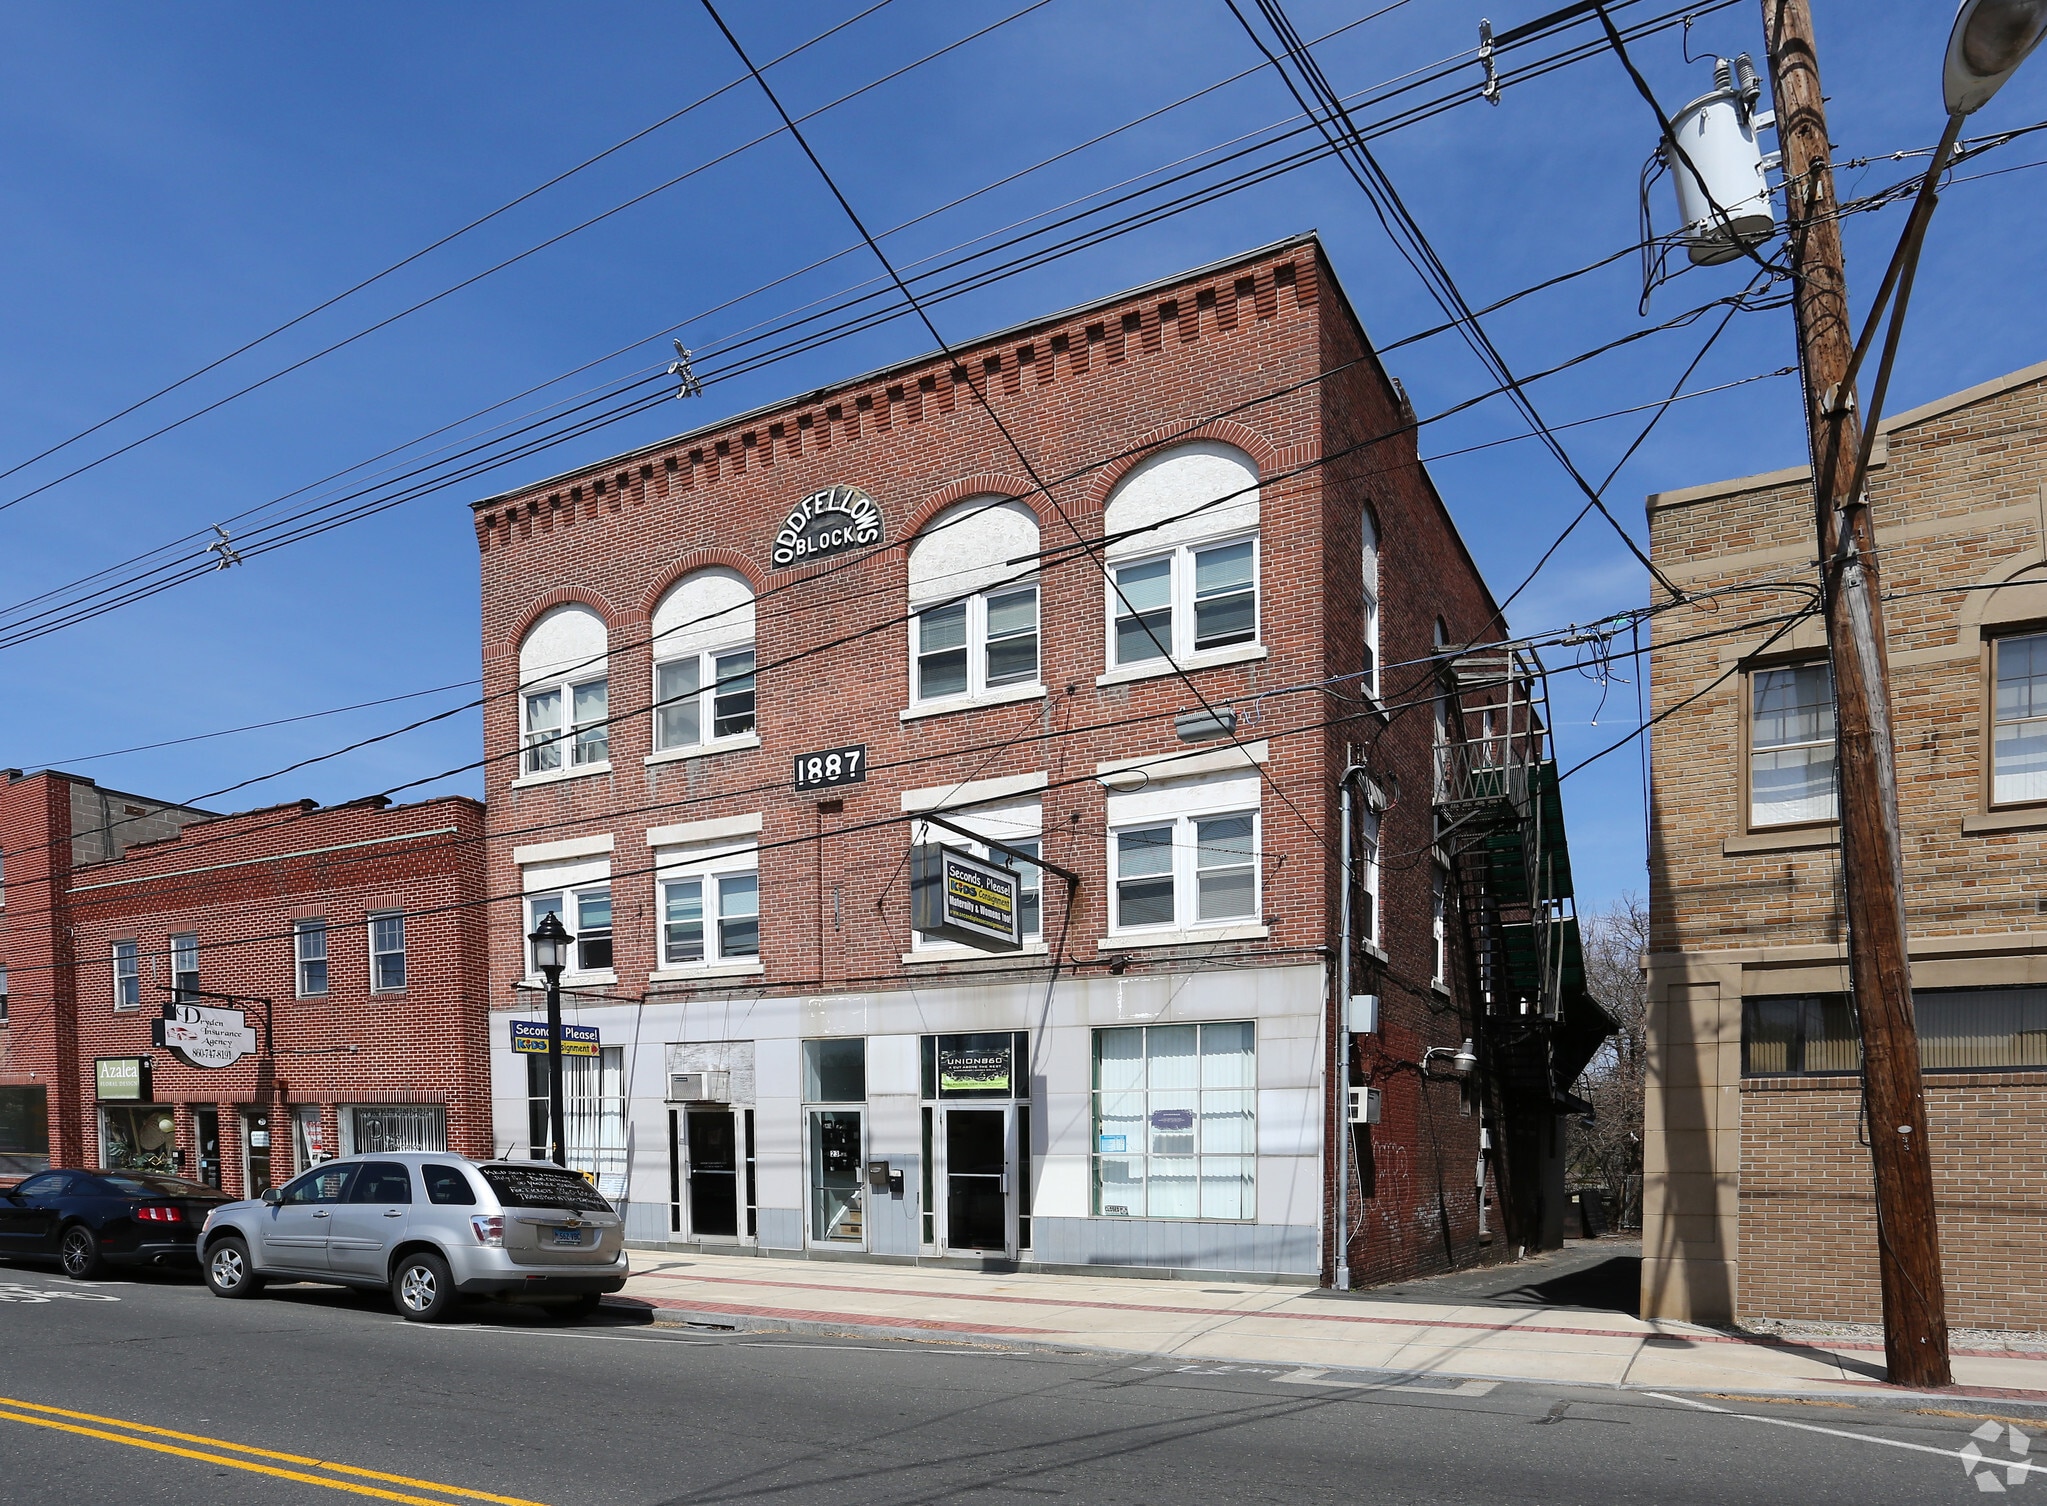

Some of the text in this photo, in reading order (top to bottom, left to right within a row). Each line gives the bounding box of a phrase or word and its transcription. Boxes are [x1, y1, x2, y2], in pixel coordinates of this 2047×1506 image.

[796, 525, 855, 556] BLOCK
[798, 750, 860, 786] 1887
[949, 865, 1011, 897] Seconds, Please!
[978, 890, 1010, 908] Consignment
[949, 894, 974, 913] Maternity
[975, 904, 980, 914] &
[1001, 912, 1012, 925] too!
[176, 1006, 224, 1027] Dryden
[200, 1027, 242, 1038] Insurance
[565, 1027, 598, 1041] Please!
[201, 1037, 233, 1048] Agency
[100, 1060, 138, 1078] Azalea
[947, 1057, 1002, 1065] UNION860
